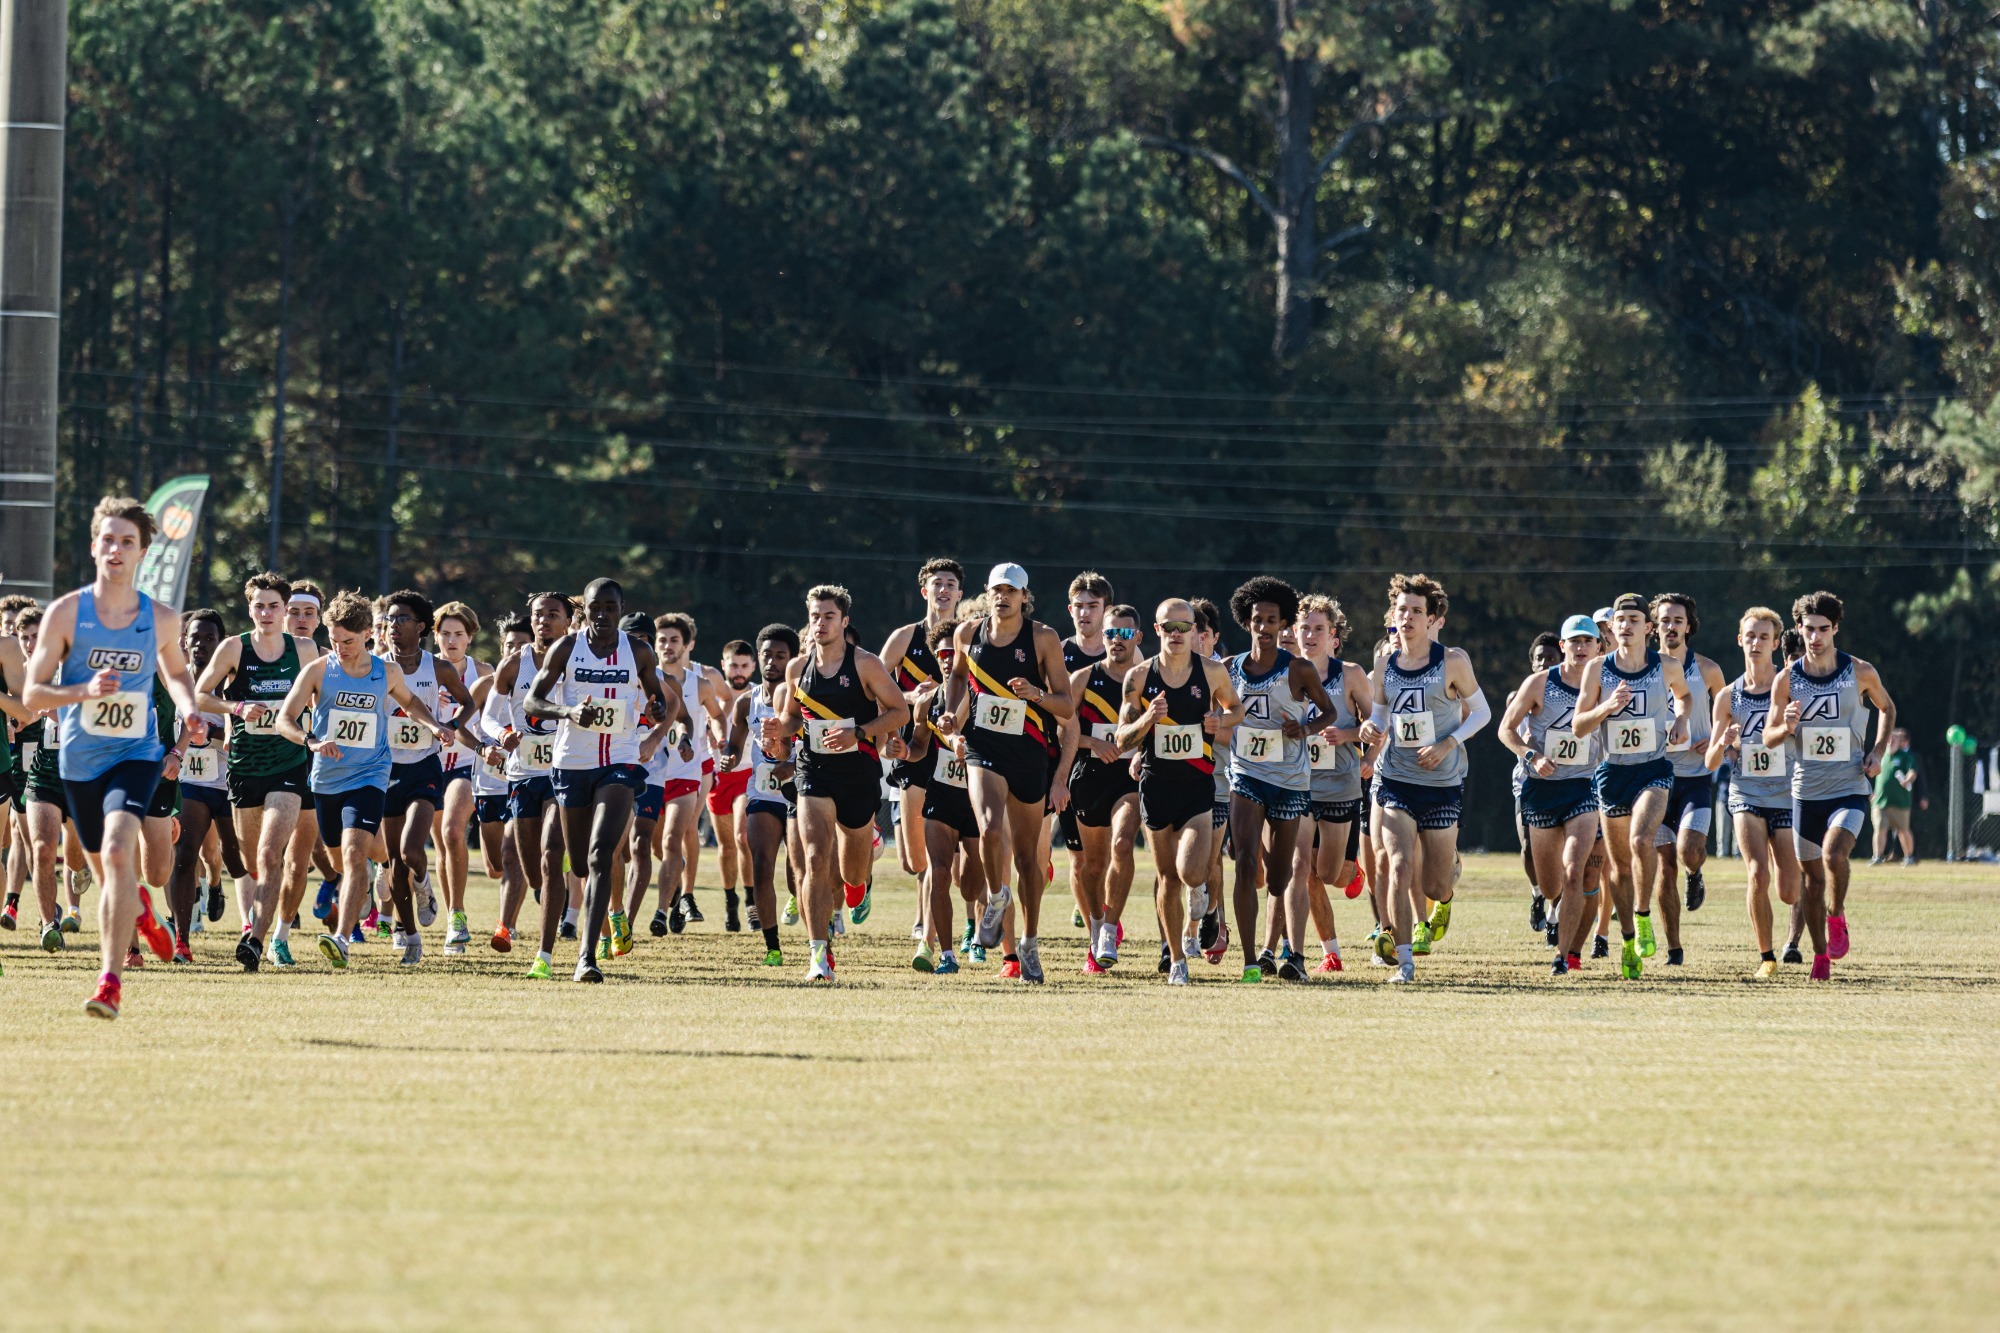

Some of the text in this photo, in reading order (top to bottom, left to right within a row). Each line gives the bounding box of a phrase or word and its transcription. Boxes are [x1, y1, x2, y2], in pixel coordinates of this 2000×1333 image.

[90, 650, 142, 672] USCB
[575, 668, 630, 684] USCA
[337, 692, 376, 709] USCB
[1799, 692, 1839, 721] A
[94, 702, 134, 729] 208
[594, 706, 615, 728] 93
[989, 705, 1010, 727] 97
[337, 720, 367, 742] 207
[400, 725, 419, 744] 53
[1402, 722, 1420, 742] 21
[1621, 728, 1641, 748] 26
[1163, 733, 1192, 753] 100
[1250, 736, 1267, 757] 27
[1557, 740, 1577, 759] 20
[1816, 735, 1835, 755] 28
[534, 744, 553, 765] 45
[1753, 752, 1770, 771] 19
[189, 756, 204, 776] 44
[947, 760, 965, 781] 94
